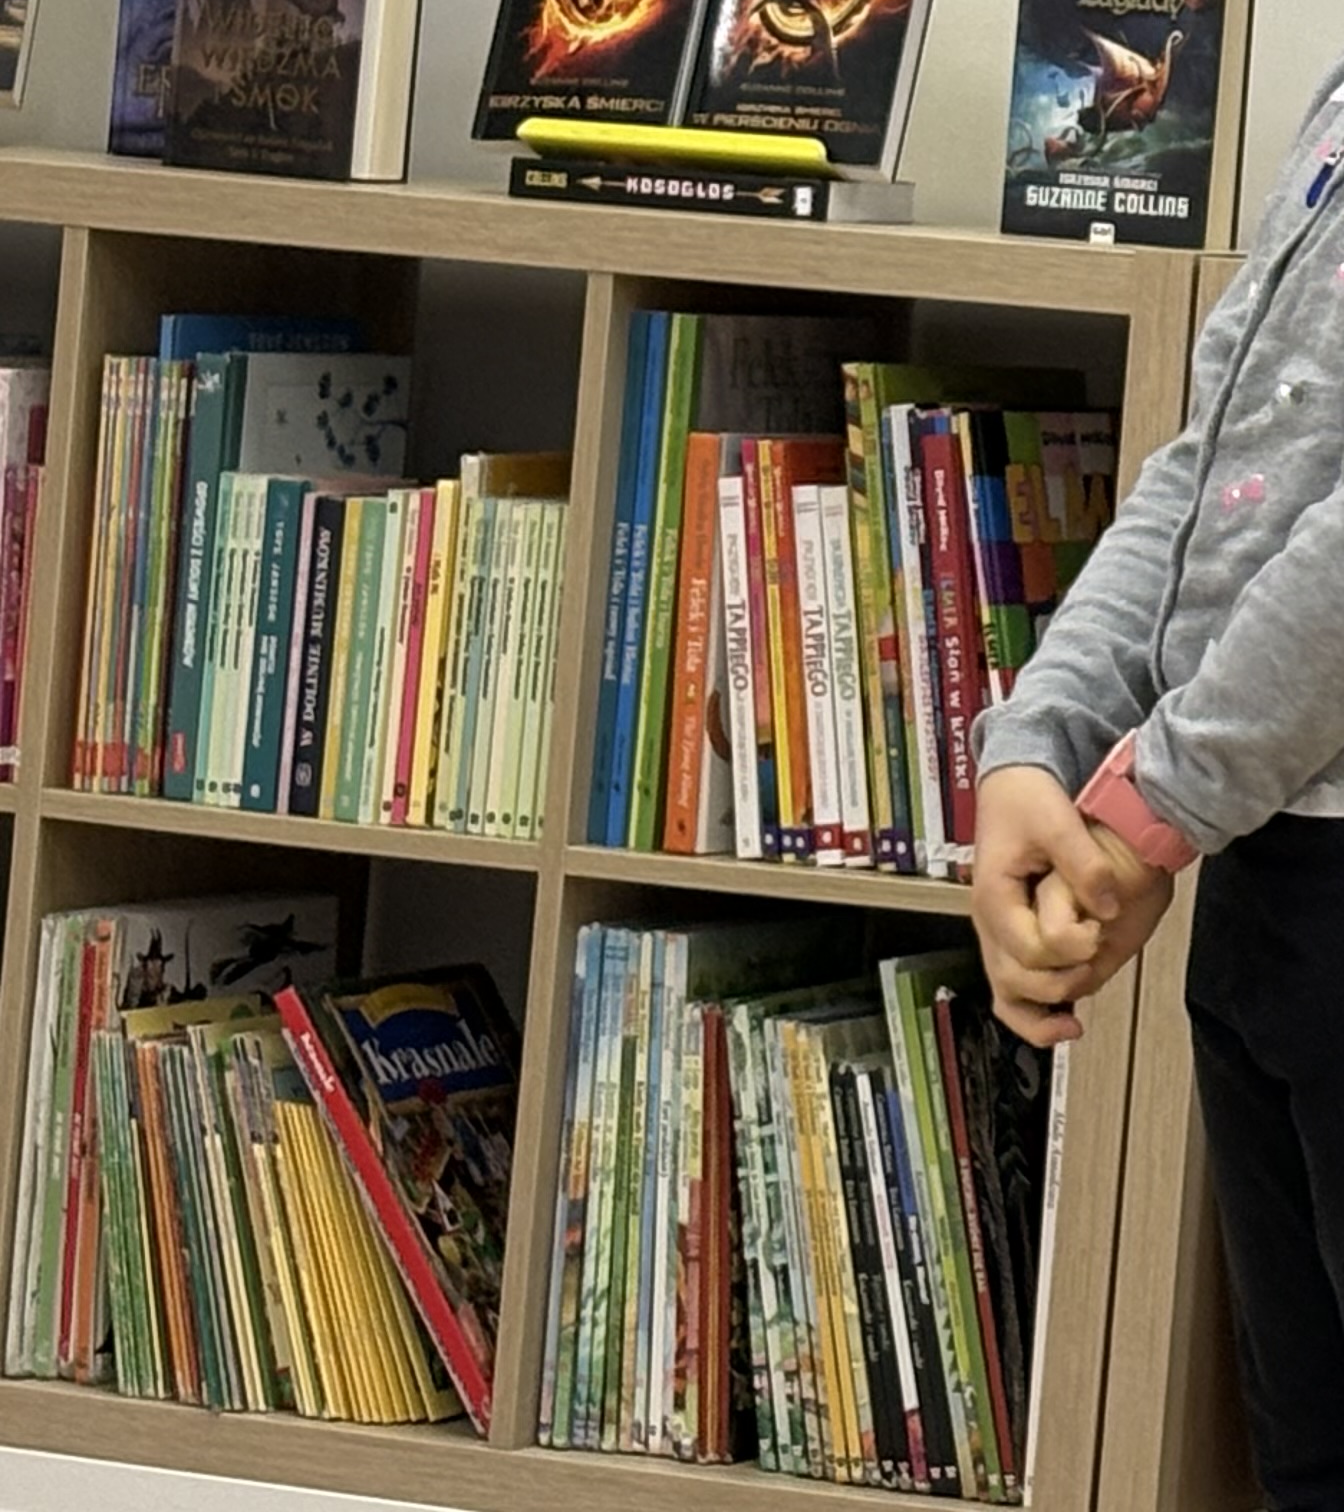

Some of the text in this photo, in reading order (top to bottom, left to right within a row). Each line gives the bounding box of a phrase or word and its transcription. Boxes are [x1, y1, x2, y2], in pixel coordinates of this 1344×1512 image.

[1025, 184, 1190, 219] SUZANNE COLLINS
[310, 525, 334, 641] MUMINKÓW
[304, 643, 323, 722] DOLINIE
[726, 602, 749, 692] TAPPIEGO
[802, 602, 828, 698] TAPPIEGO
[362, 1018, 498, 1087] Krasnale
